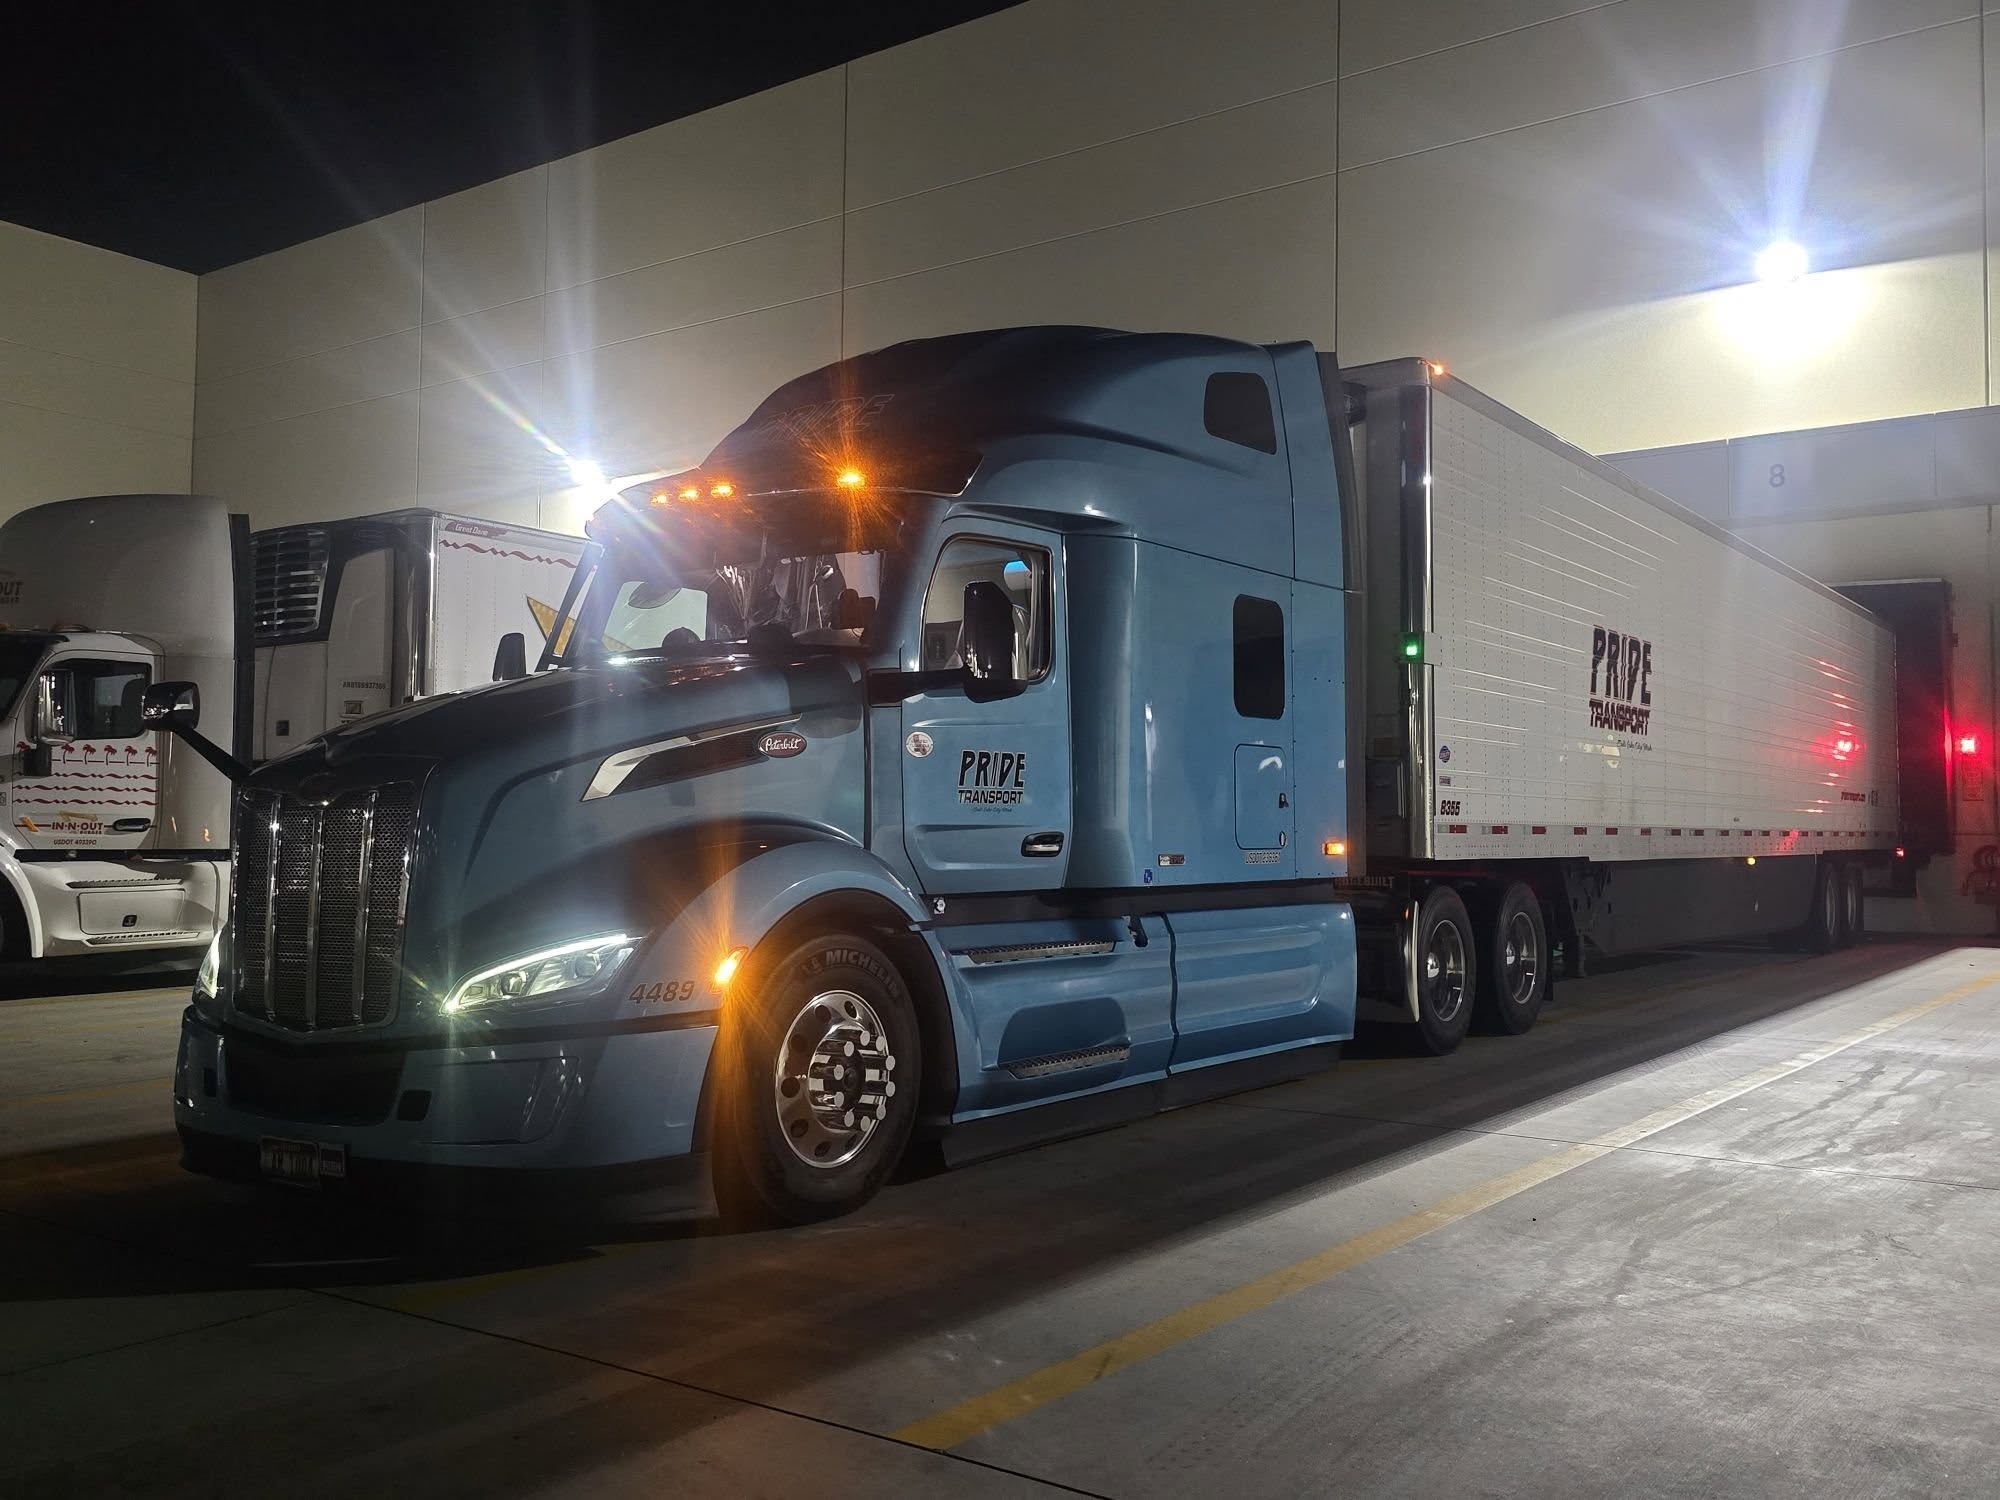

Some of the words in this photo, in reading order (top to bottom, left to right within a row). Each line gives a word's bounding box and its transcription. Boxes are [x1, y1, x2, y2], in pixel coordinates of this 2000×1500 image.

[1769, 463, 1786, 488] 8
[1590, 624, 1652, 706] PRIDE
[1588, 698, 1651, 736] TRANSPORT
[958, 750, 1026, 788] PRIDE
[958, 789, 1024, 804] TRANSPORT
[628, 980, 695, 1004] 4489
[825, 949, 900, 998] MICHELIN
